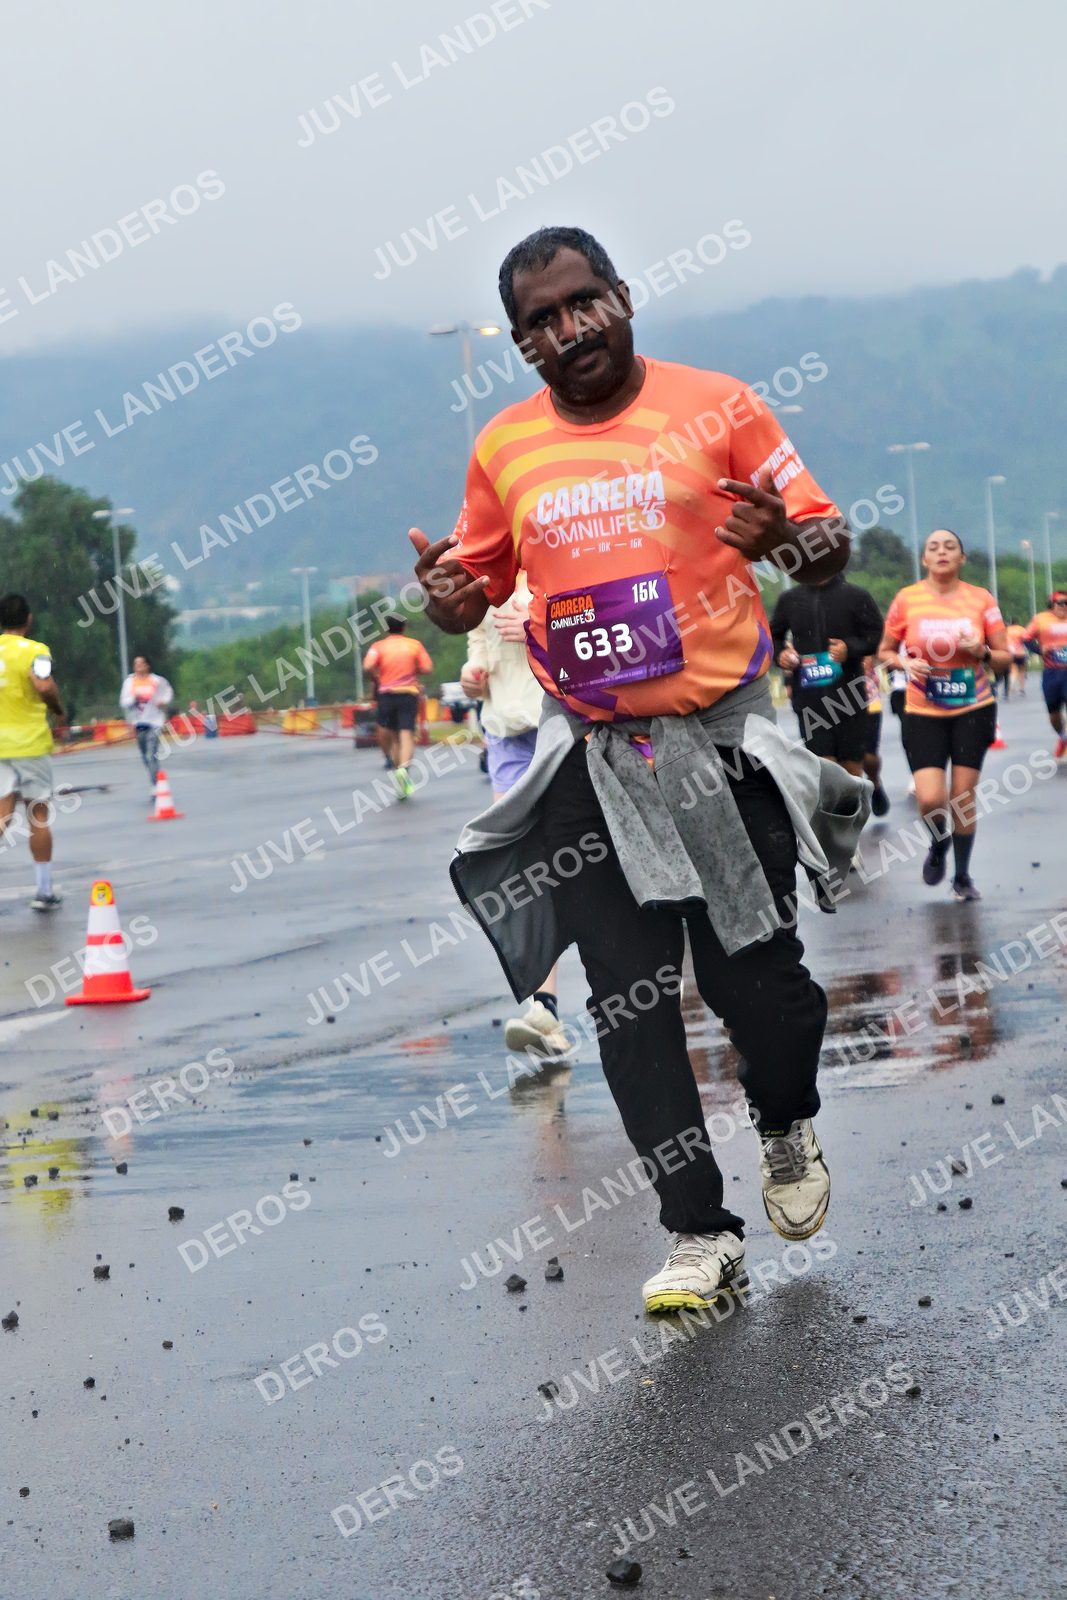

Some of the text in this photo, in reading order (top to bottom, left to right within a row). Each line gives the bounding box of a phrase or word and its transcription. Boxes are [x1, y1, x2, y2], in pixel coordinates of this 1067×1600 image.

[537, 470, 665, 525] CARRERA
[544, 512, 639, 548] OMNILIFE
[632, 579, 659, 604] 15K
[550, 594, 594, 618] CARRERA
[550, 613, 585, 630] OMNILIFE
[574, 623, 633, 661] 633
[936, 682, 967, 697] 1299
